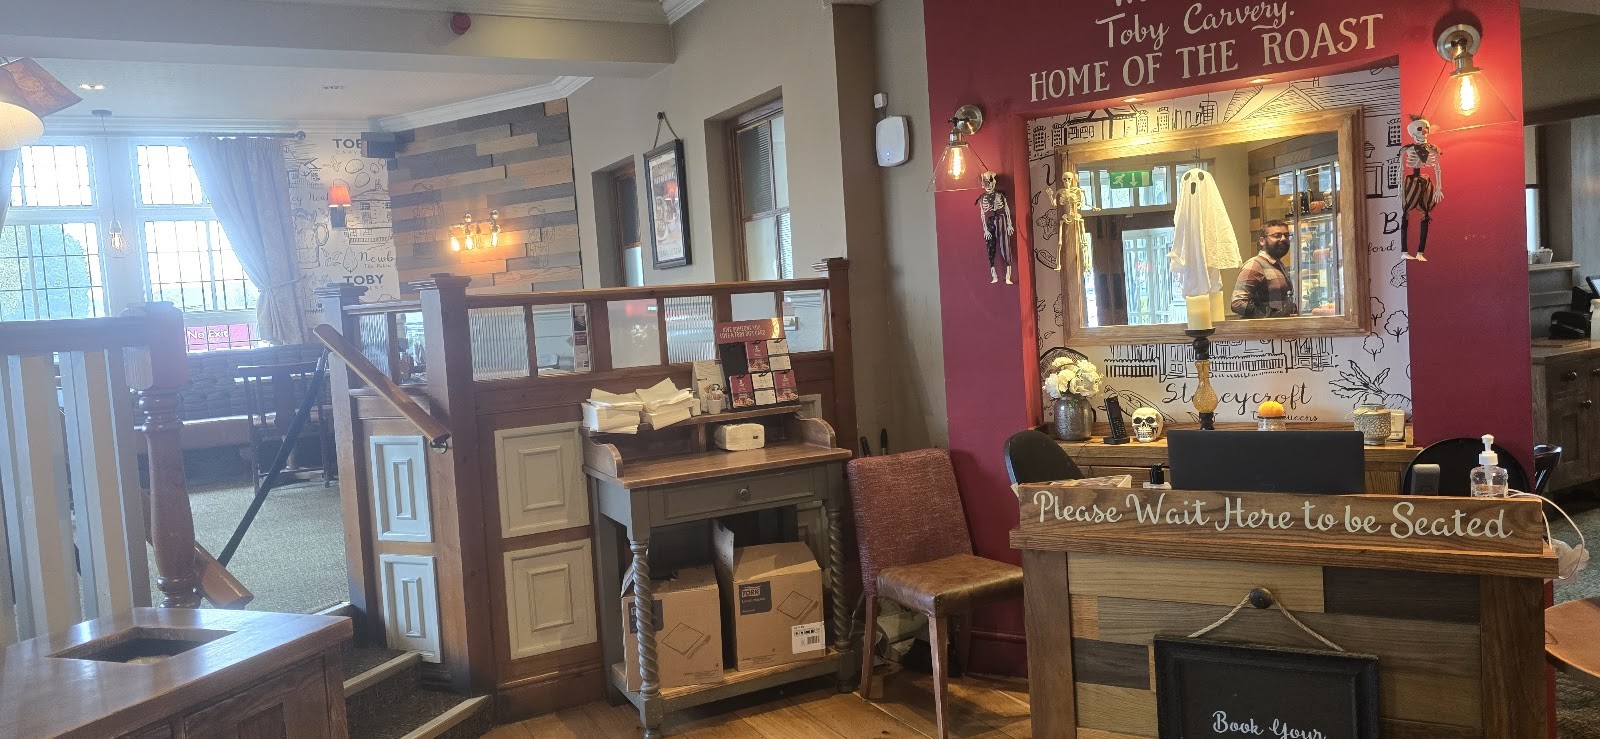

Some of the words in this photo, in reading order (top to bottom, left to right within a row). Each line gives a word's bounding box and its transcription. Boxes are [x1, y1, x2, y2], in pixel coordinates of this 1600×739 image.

[1095, 13, 1169, 50] Toby
[1183, 1, 1295, 35] Carvery.
[1030, 60, 1110, 102] HOME
[1122, 52, 1162, 87] OF
[1175, 39, 1239, 79] THE
[1261, 13, 1384, 67] ROAST
[332, 139, 362, 149] TOB
[342, 274, 384, 285] TOBY
[188, 329, 205, 340] No
[208, 328, 229, 338] Exit
[1162, 382, 1313, 416] Steycroft
[1033, 490, 1123, 523] Please
[1125, 492, 1210, 526] Wait
[1215, 496, 1295, 532] Here
[1301, 500, 1339, 531] to
[1344, 504, 1382, 534] be
[1390, 501, 1514, 539] Seated
[742, 588, 760, 598] TORK
[1212, 710, 1264, 736] Book
[1268, 718, 1327, 739] Your
